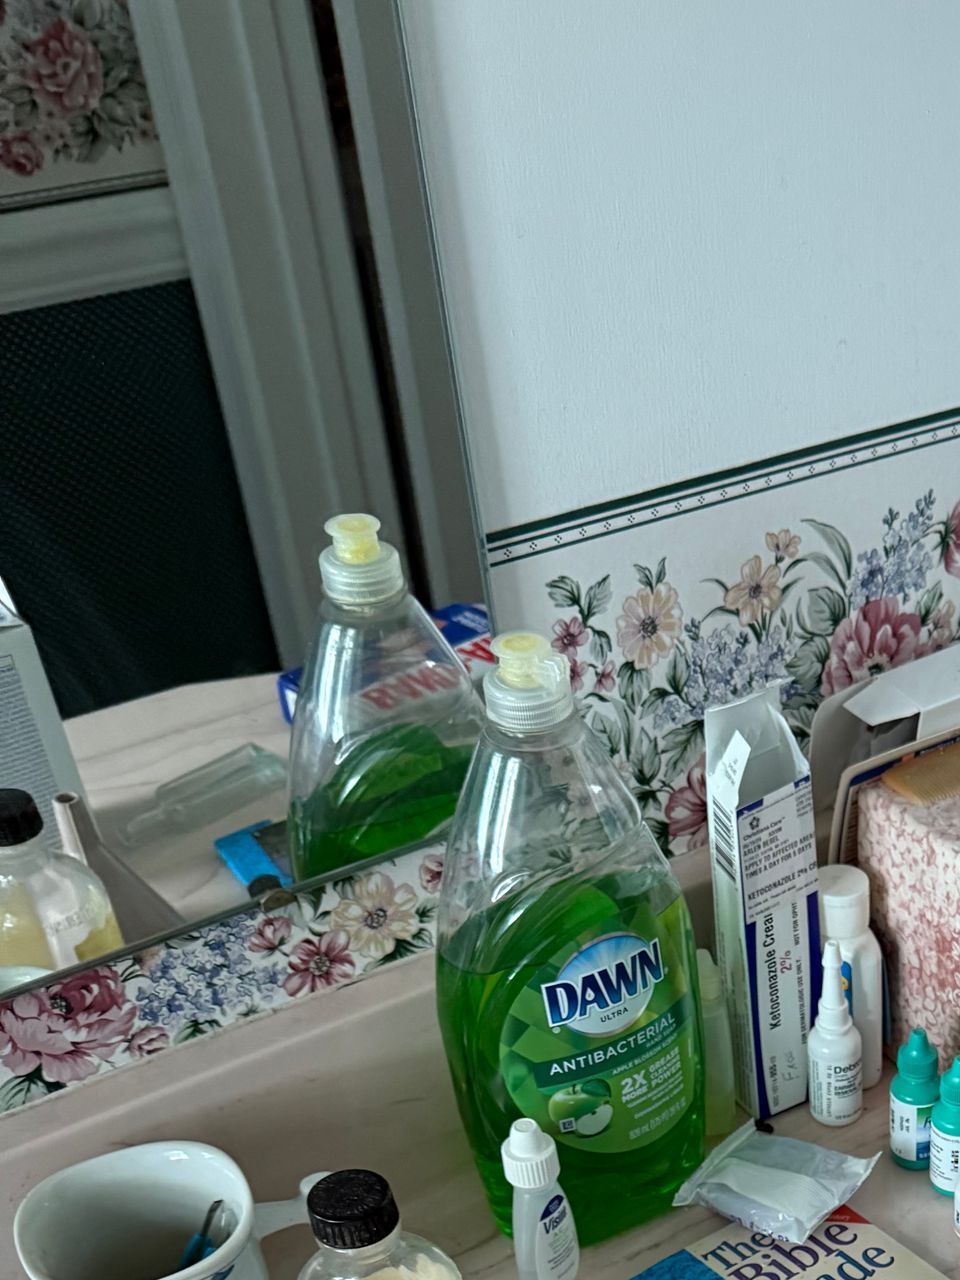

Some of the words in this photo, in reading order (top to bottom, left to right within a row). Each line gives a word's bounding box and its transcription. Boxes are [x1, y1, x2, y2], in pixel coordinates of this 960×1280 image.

[780, 950, 793, 975] 2%
[543, 941, 664, 1026] DAWN
[764, 949, 782, 1030] Ketoconazole
[600, 1007, 629, 1023] ULTRA
[550, 1014, 676, 1076] ANTIBACTERIAL
[621, 1069, 648, 1095] 2X
[651, 1061, 682, 1087] POWER
[622, 1086, 649, 1103] MORE
[701, 1230, 775, 1271] The
